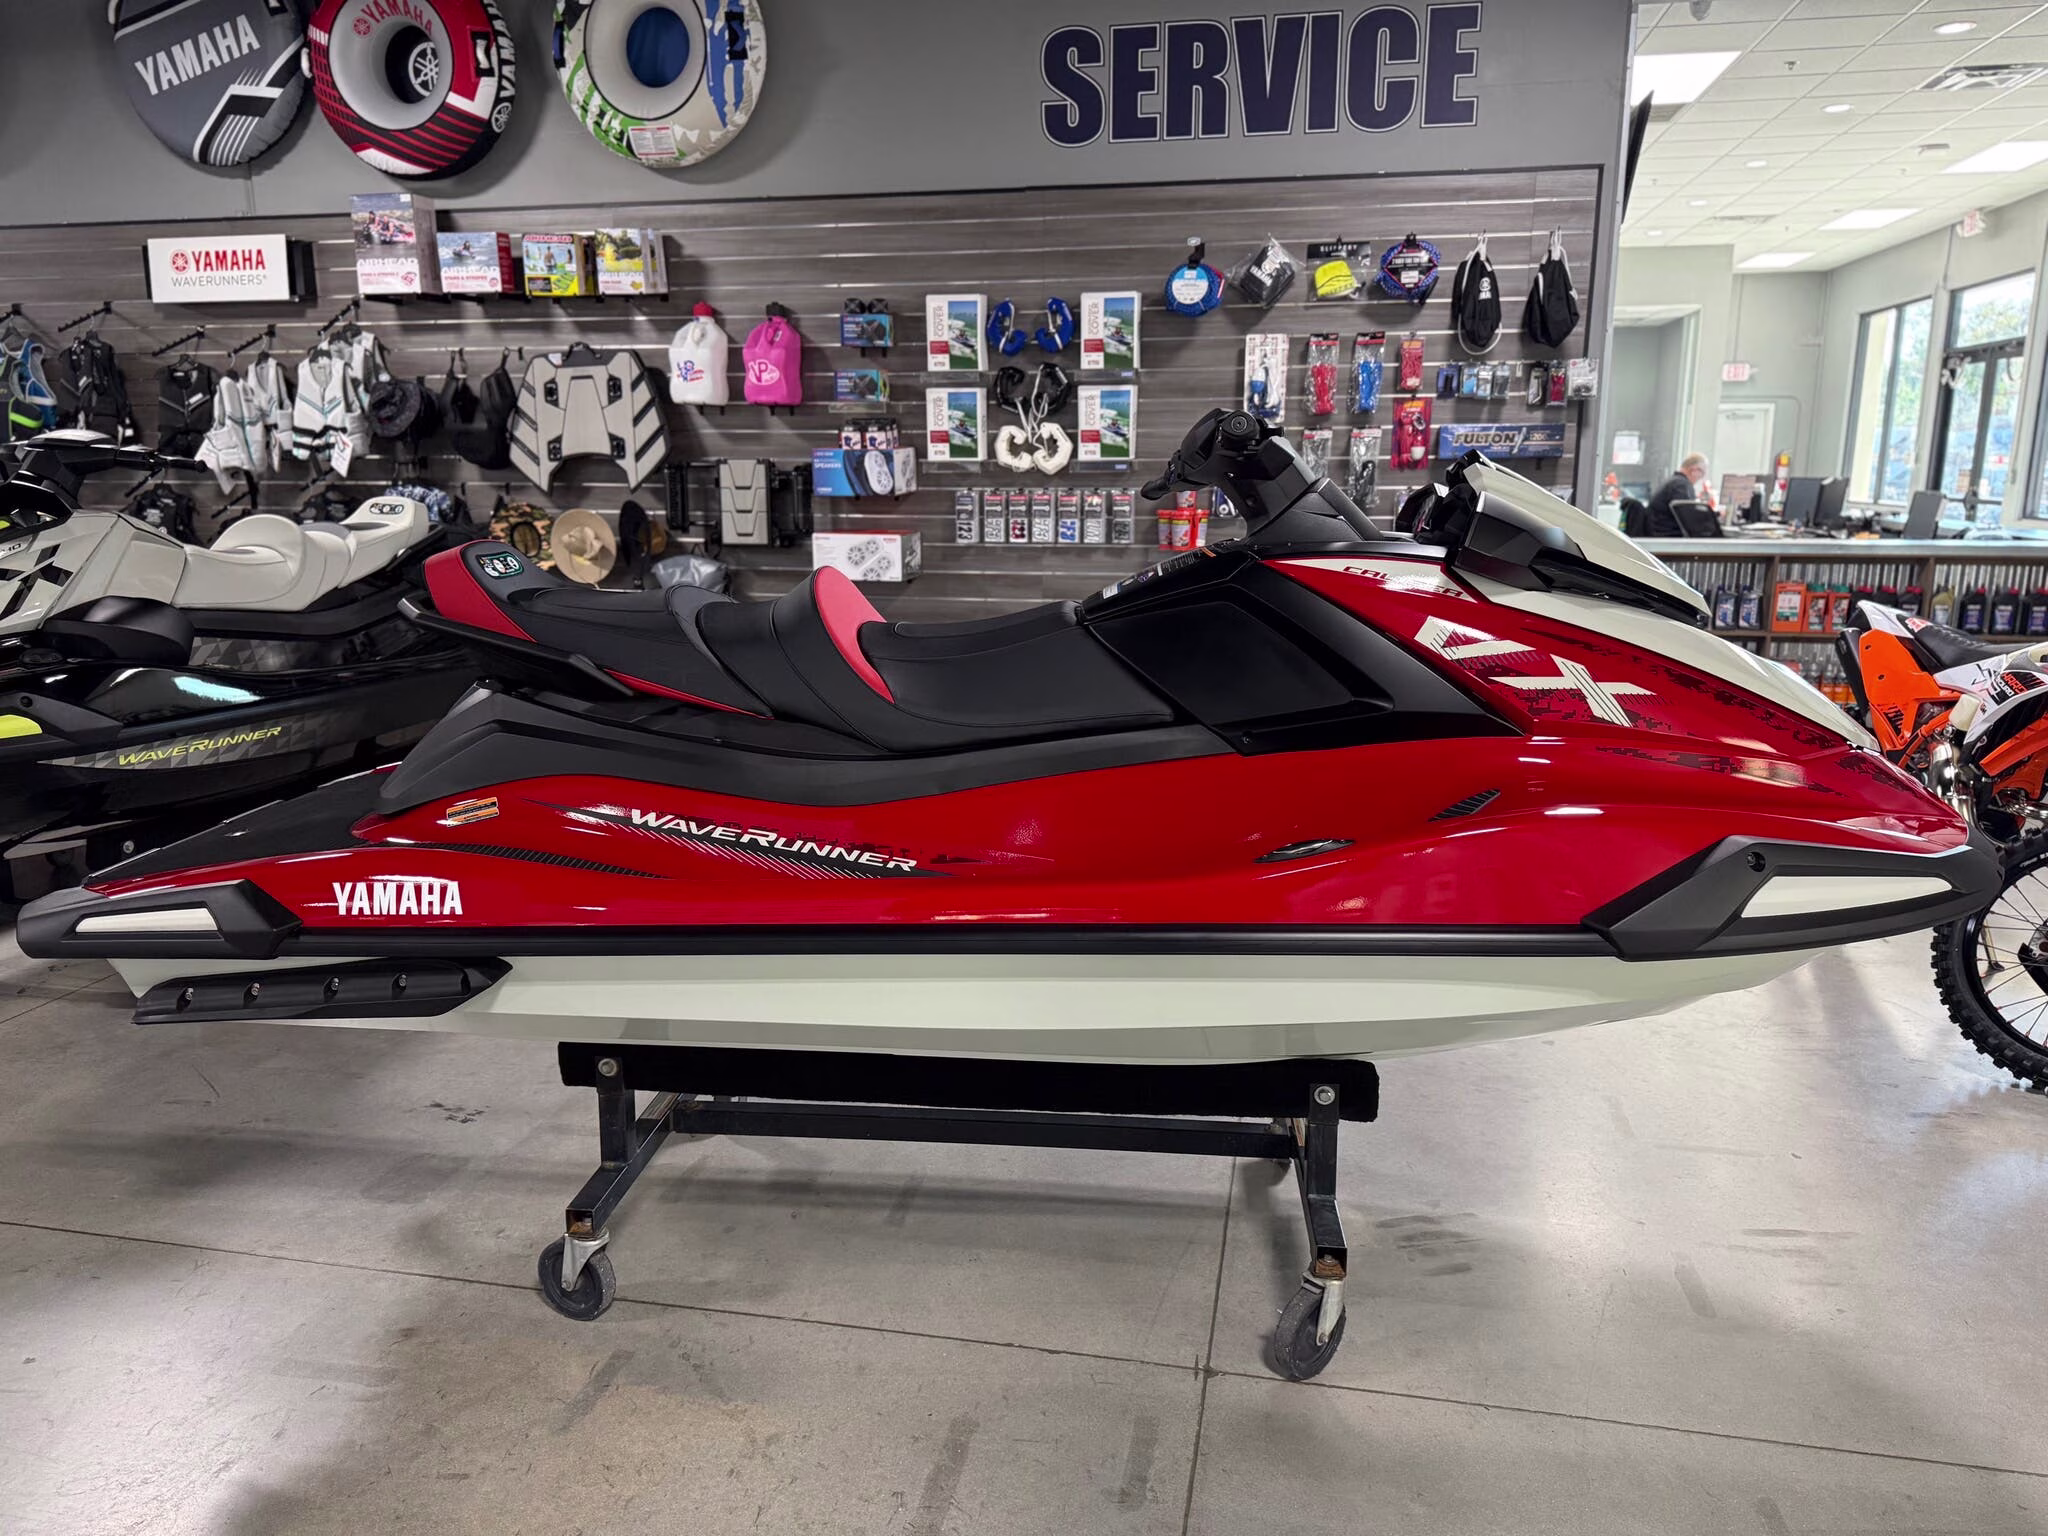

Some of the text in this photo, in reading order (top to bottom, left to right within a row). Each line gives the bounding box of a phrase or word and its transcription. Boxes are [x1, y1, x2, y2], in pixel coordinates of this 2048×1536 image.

[361, 0, 433, 36] YAMAHA
[134, 14, 261, 96] YAMAHA
[1040, 2, 1482, 148] SERVICE
[192, 249, 266, 272] YAMAHA
[936, 305, 945, 338] COVER
[1093, 302, 1101, 335] COVER
[1087, 394, 1096, 426] COVER
[1453, 431, 1518, 446] FULTON
[1342, 565, 1464, 598] CALER
[332, 881, 463, 915] YAMAHA
